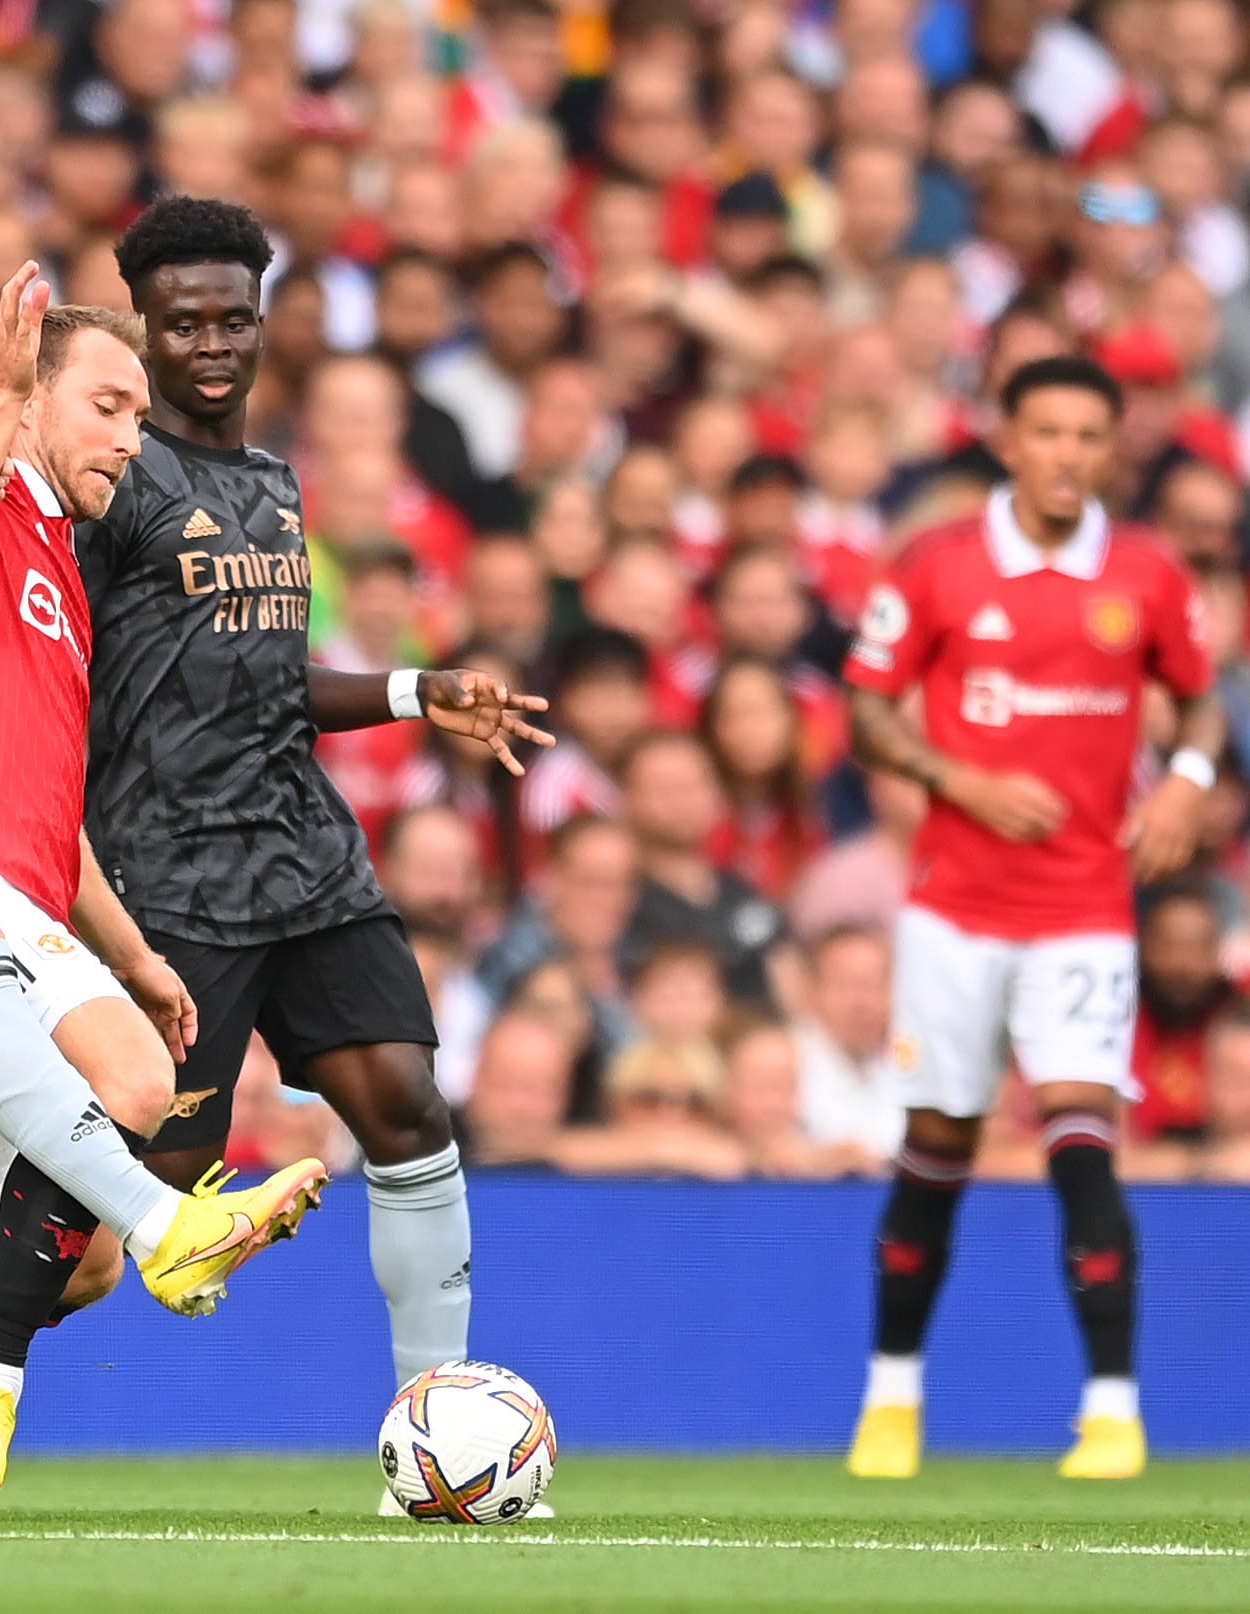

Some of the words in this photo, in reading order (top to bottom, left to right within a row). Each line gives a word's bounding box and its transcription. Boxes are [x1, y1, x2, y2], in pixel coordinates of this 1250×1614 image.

[177, 543, 312, 597] Emirate
[214, 596, 253, 633] FLY
[258, 595, 309, 631] BETTE
